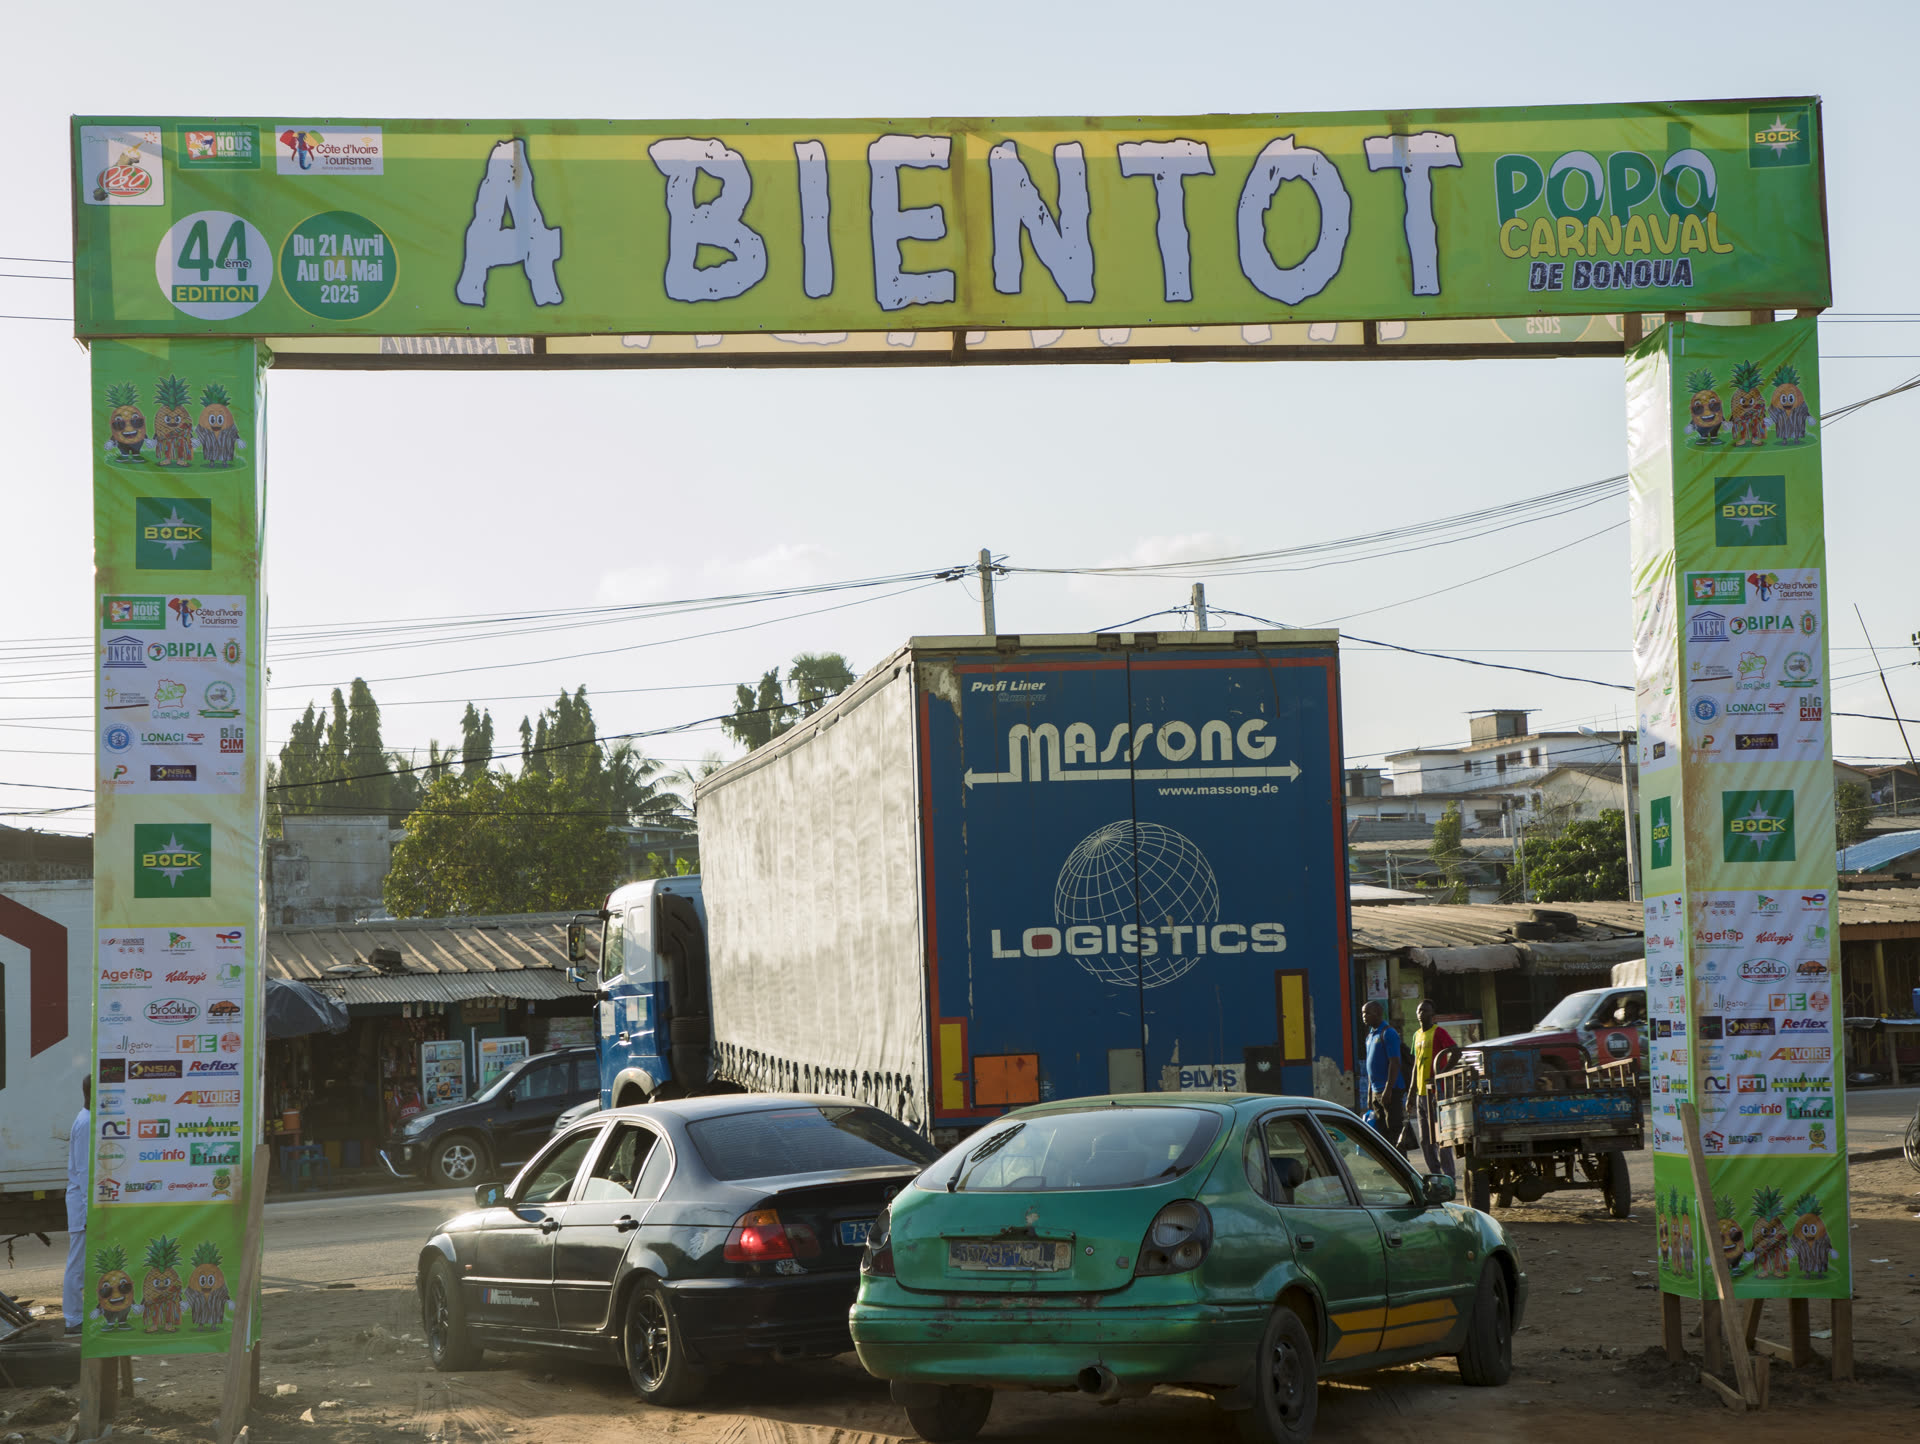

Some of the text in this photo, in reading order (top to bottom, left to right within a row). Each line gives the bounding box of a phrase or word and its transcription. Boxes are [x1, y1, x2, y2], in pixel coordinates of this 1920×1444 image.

[217, 136, 252, 150] NOUS
[1755, 131, 1800, 143] BOCK
[317, 144, 378, 154] Côte d'Ivoire
[324, 156, 372, 165] Tourisme
[1494, 148, 1718, 228] POPO
[456, 132, 1462, 310] A BIENTOT
[1499, 211, 1734, 259] CARNAVAL
[293, 234, 384, 256] Du 21 Avril
[297, 260, 383, 281] Au 04 Mai
[1528, 258, 1693, 291] DE BONOUA
[176, 286, 254, 302] EDITION
[320, 286, 359, 303] 2025
[1723, 504, 1777, 517] BOCK
[144, 527, 203, 540] BOCK
[1715, 580, 1740, 592] NOUS
[1773, 582, 1818, 590] Côte d'Ivoire
[133, 604, 160, 616] NOUS
[196, 608, 243, 617] Côte d'Ivoire
[201, 616, 238, 625] Tourisme
[1748, 616, 1794, 630] BIPIA
[1693, 621, 1725, 636] UNESCO
[108, 646, 142, 661] UNESCO
[167, 642, 217, 658] BIPIA
[971, 680, 1046, 692] Profi Liner
[1800, 694, 1822, 708] BIG
[1726, 704, 1766, 712] LONACI
[1800, 708, 1822, 717] CIM
[141, 733, 184, 742] LONACI
[220, 725, 244, 738] BIG
[220, 739, 244, 749] CIM
[1008, 719, 1277, 782] MASSONG
[1158, 783, 1278, 798] www.massong.de
[1730, 819, 1786, 832] BOCK
[1653, 826, 1670, 840] BOCK
[142, 854, 202, 866] BOCK
[991, 922, 1287, 958] LOGISTICS
[1696, 930, 1744, 942] Agefop
[1756, 931, 1794, 945] Kellogg's
[102, 968, 152, 982] Agefop
[166, 970, 207, 984] Kellogg's
[1743, 964, 1786, 980] Brooklyn
[150, 1004, 197, 1021] Brooklyn
[1740, 1022, 1769, 1030] NSIA
[1782, 1018, 1828, 1028] Reflex
[190, 1060, 238, 1071] Reflex
[1740, 1078, 1765, 1089] RTI
[1739, 1104, 1782, 1114] soirinfo
[1789, 1108, 1832, 1118] L'inter
[140, 1125, 168, 1135] RTI
[139, 1149, 186, 1160] soirinfo
[192, 1154, 239, 1164] L'inter
